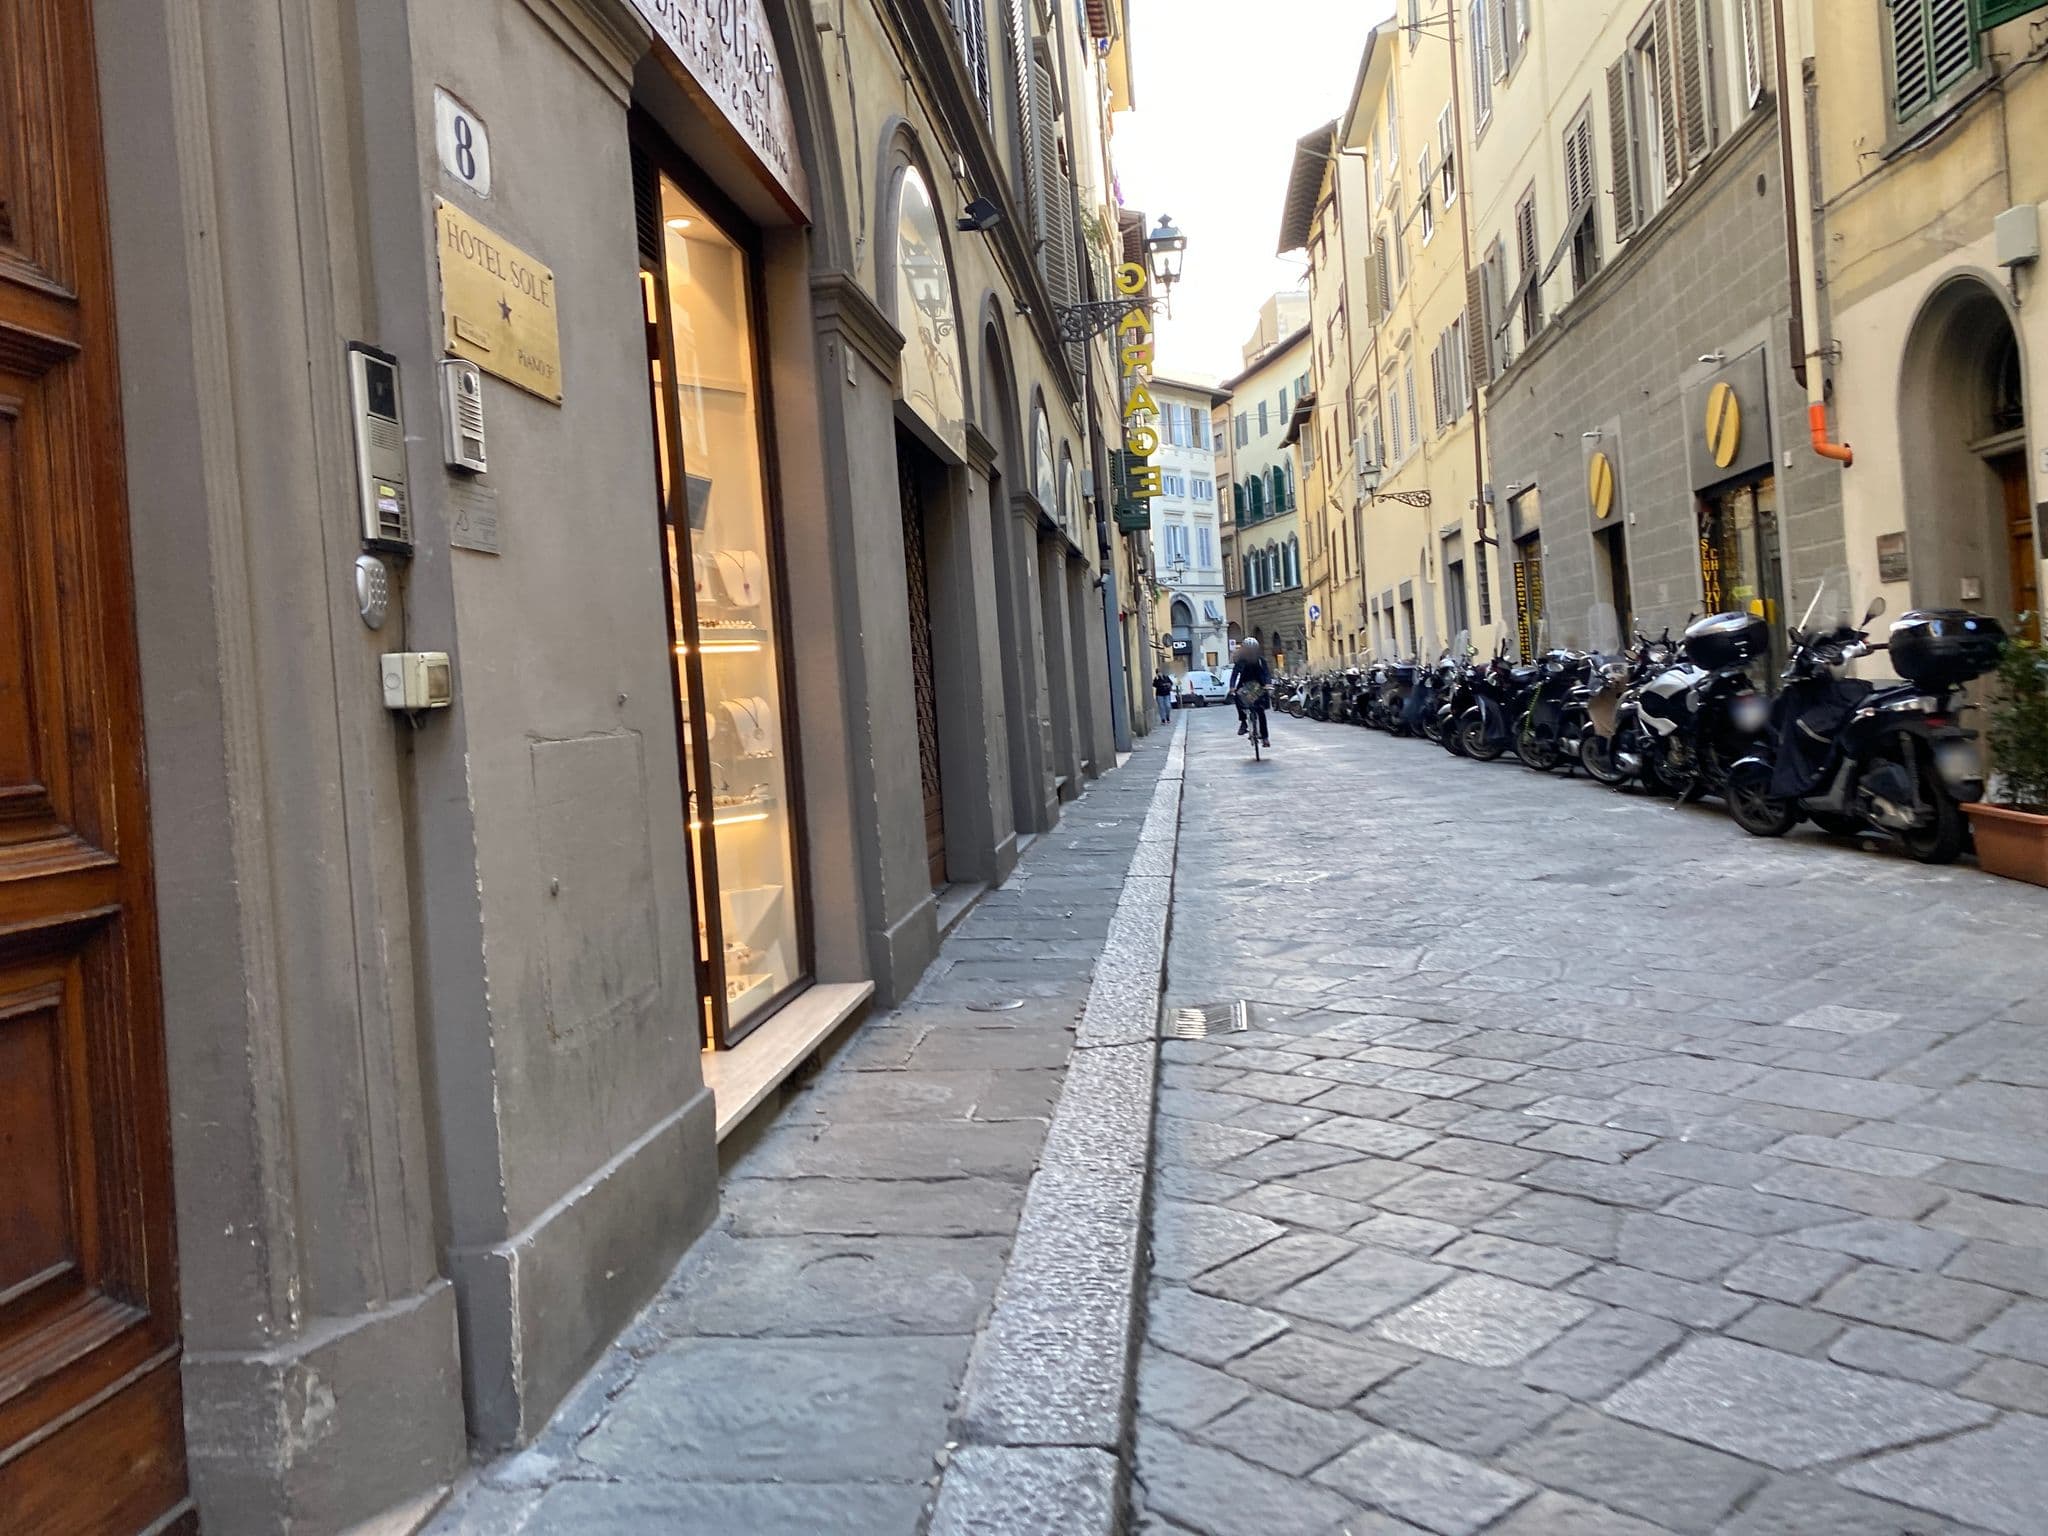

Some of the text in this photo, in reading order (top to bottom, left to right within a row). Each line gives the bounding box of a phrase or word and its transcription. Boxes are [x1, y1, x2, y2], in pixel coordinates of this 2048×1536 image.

[454, 115, 476, 180] 8
[446, 219, 550, 308] HOTEL SOLE
